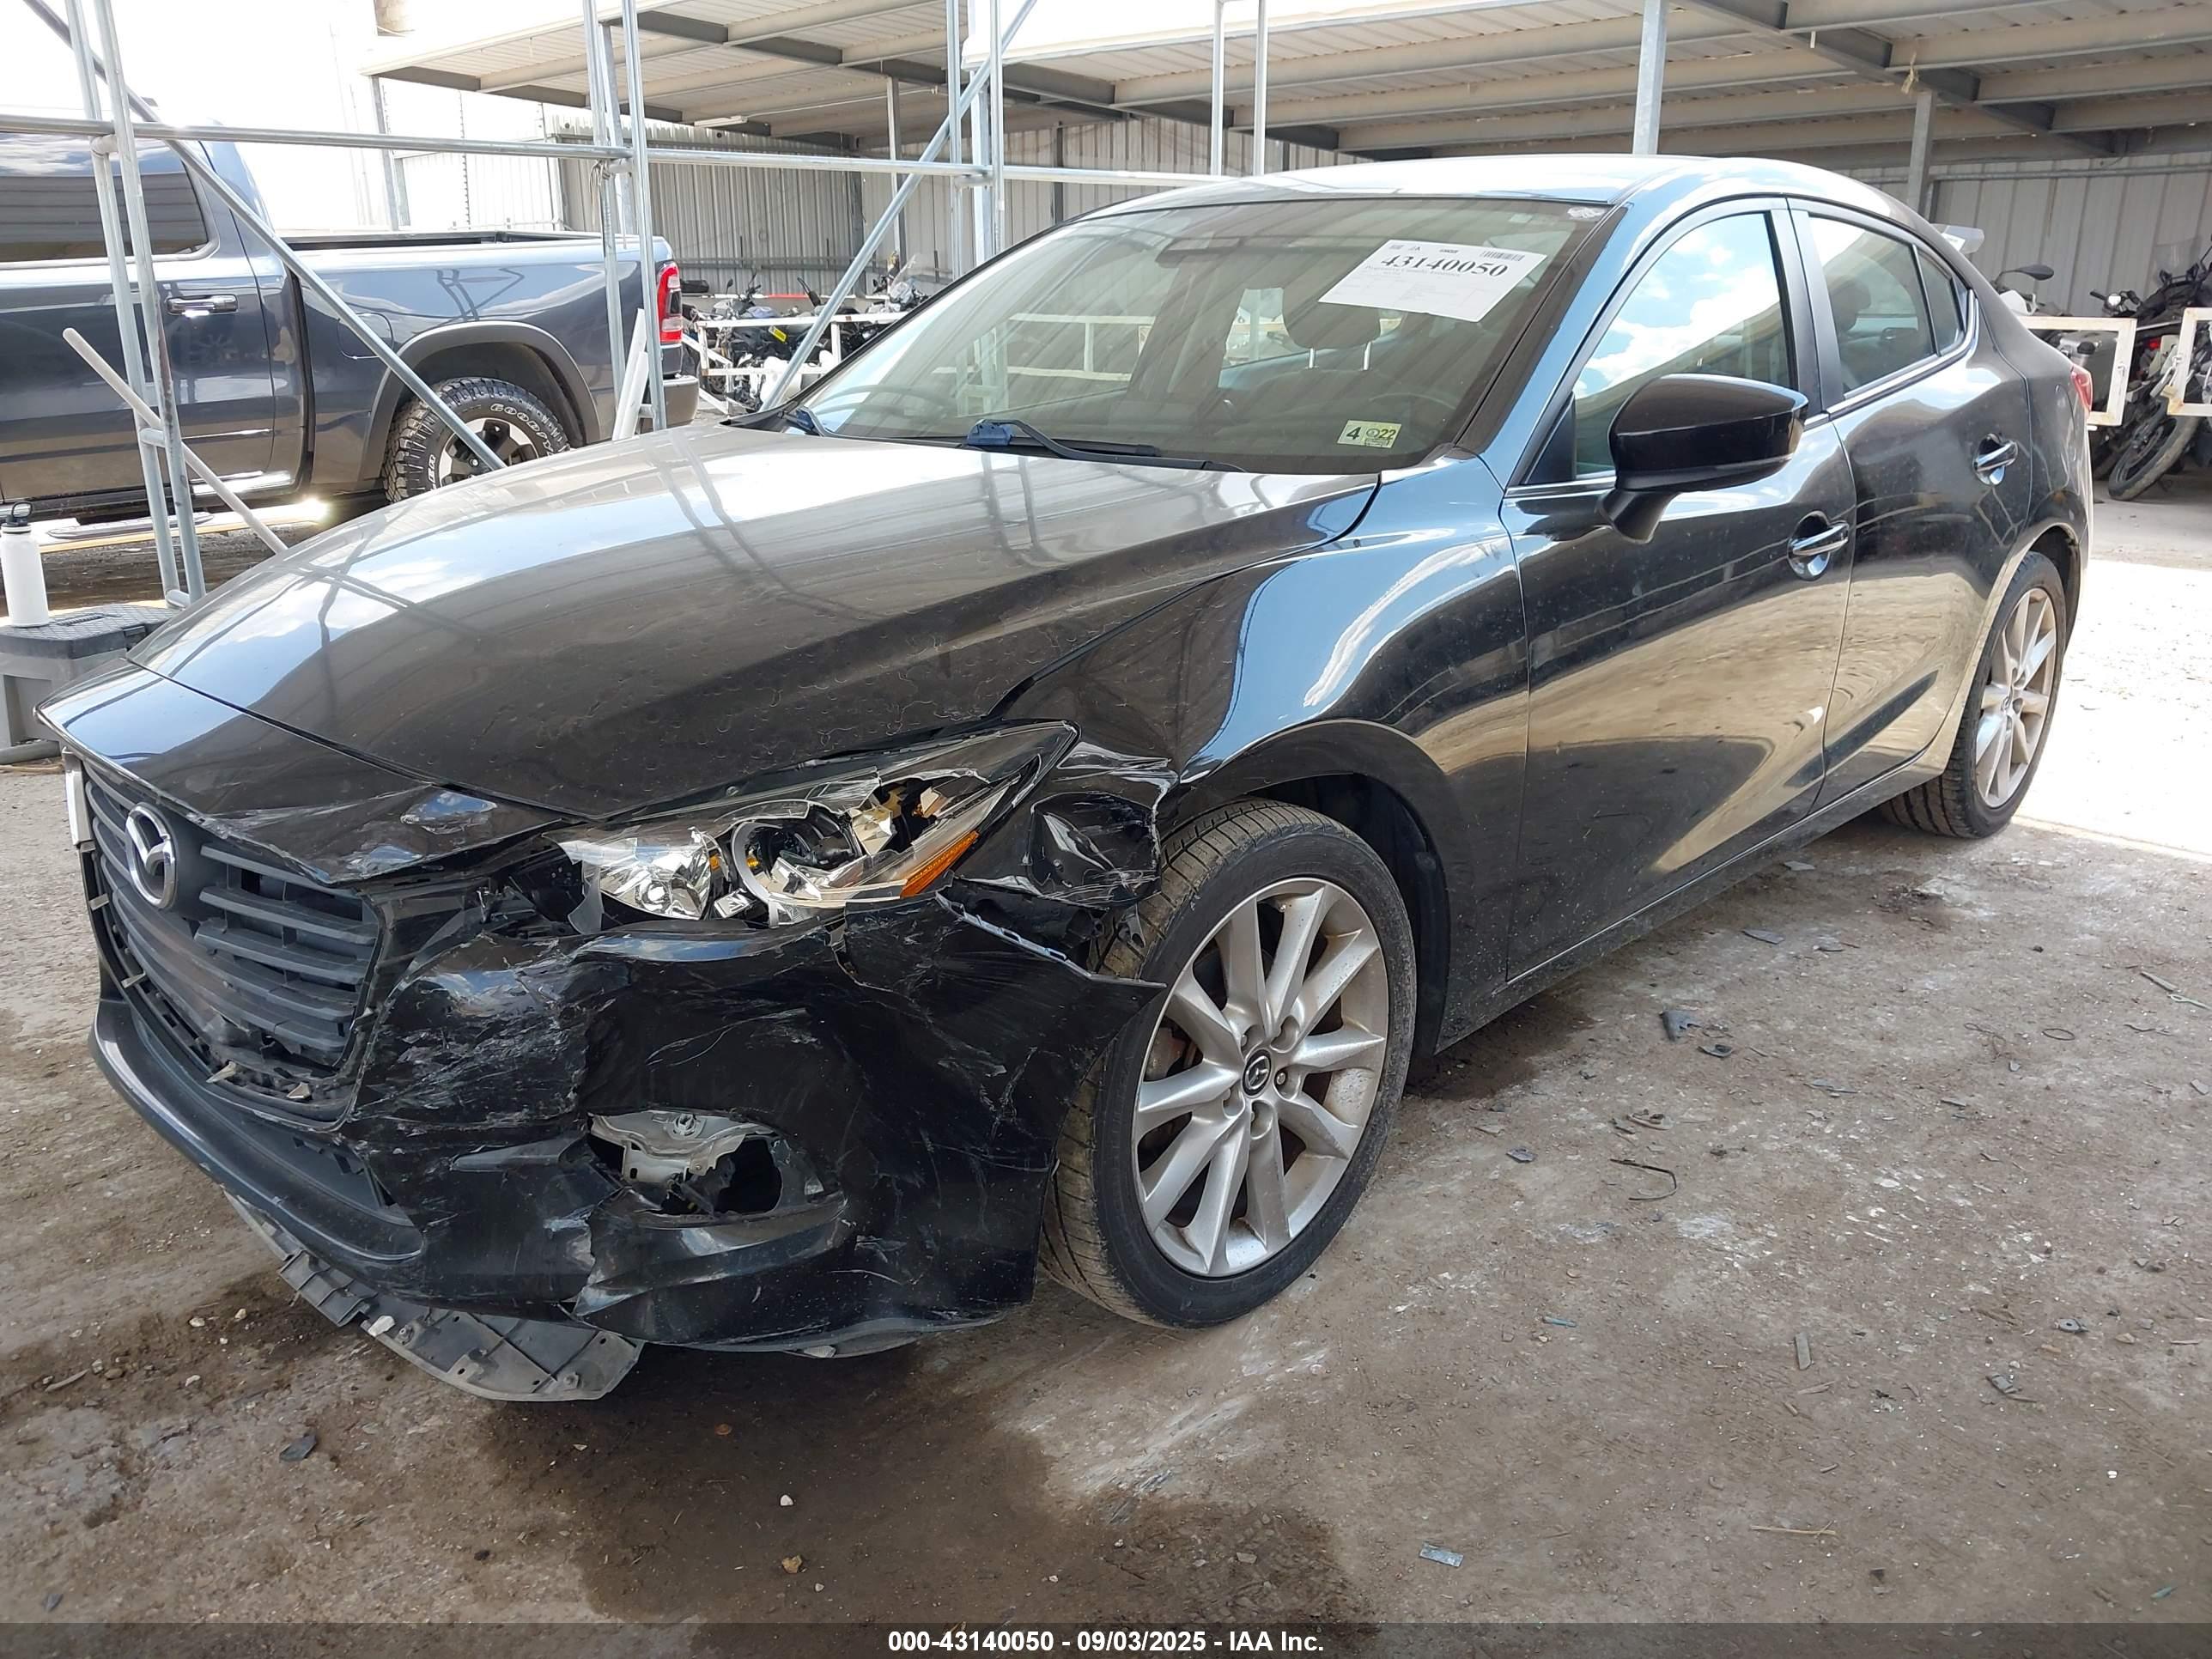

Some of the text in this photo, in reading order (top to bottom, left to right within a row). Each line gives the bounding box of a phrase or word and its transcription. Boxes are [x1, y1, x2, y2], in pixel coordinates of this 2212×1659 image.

[1381, 254, 1509, 277] 43140050
[1346, 426, 1397, 441] 4 22
